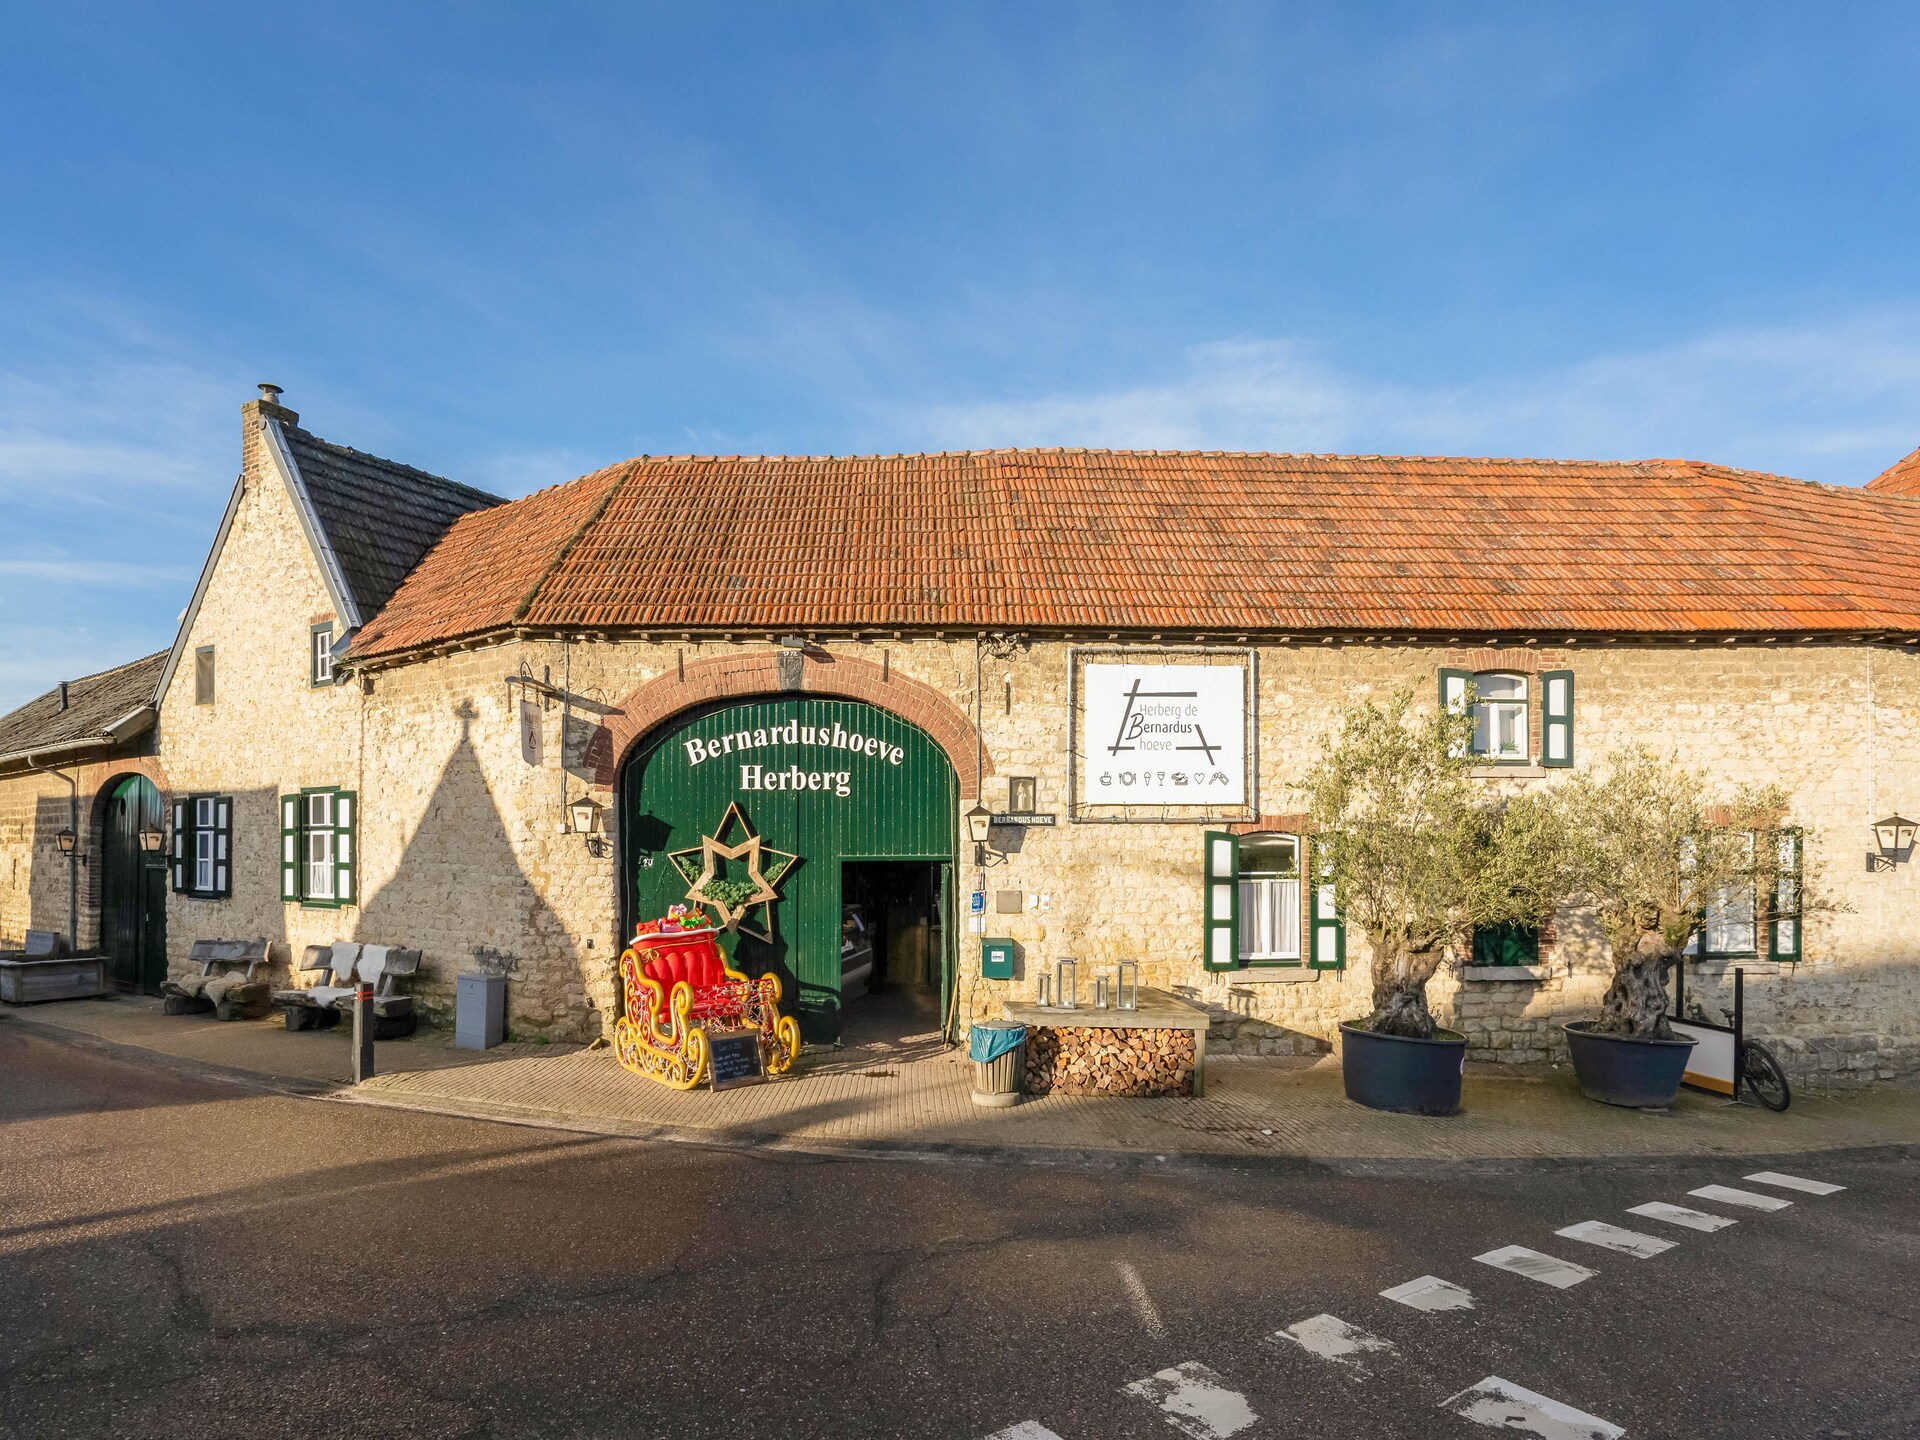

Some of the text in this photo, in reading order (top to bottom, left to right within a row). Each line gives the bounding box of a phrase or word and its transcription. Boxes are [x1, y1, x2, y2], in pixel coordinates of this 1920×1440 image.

[1139, 703, 1198, 719] Herberg de
[1125, 713, 1192, 740] Bernardus
[684, 720, 904, 766] Bernardushoeve
[1139, 738, 1172, 753] hoeve
[740, 765, 851, 796] Herberg
[993, 816, 1052, 824] BERNARDUS HOEVE
